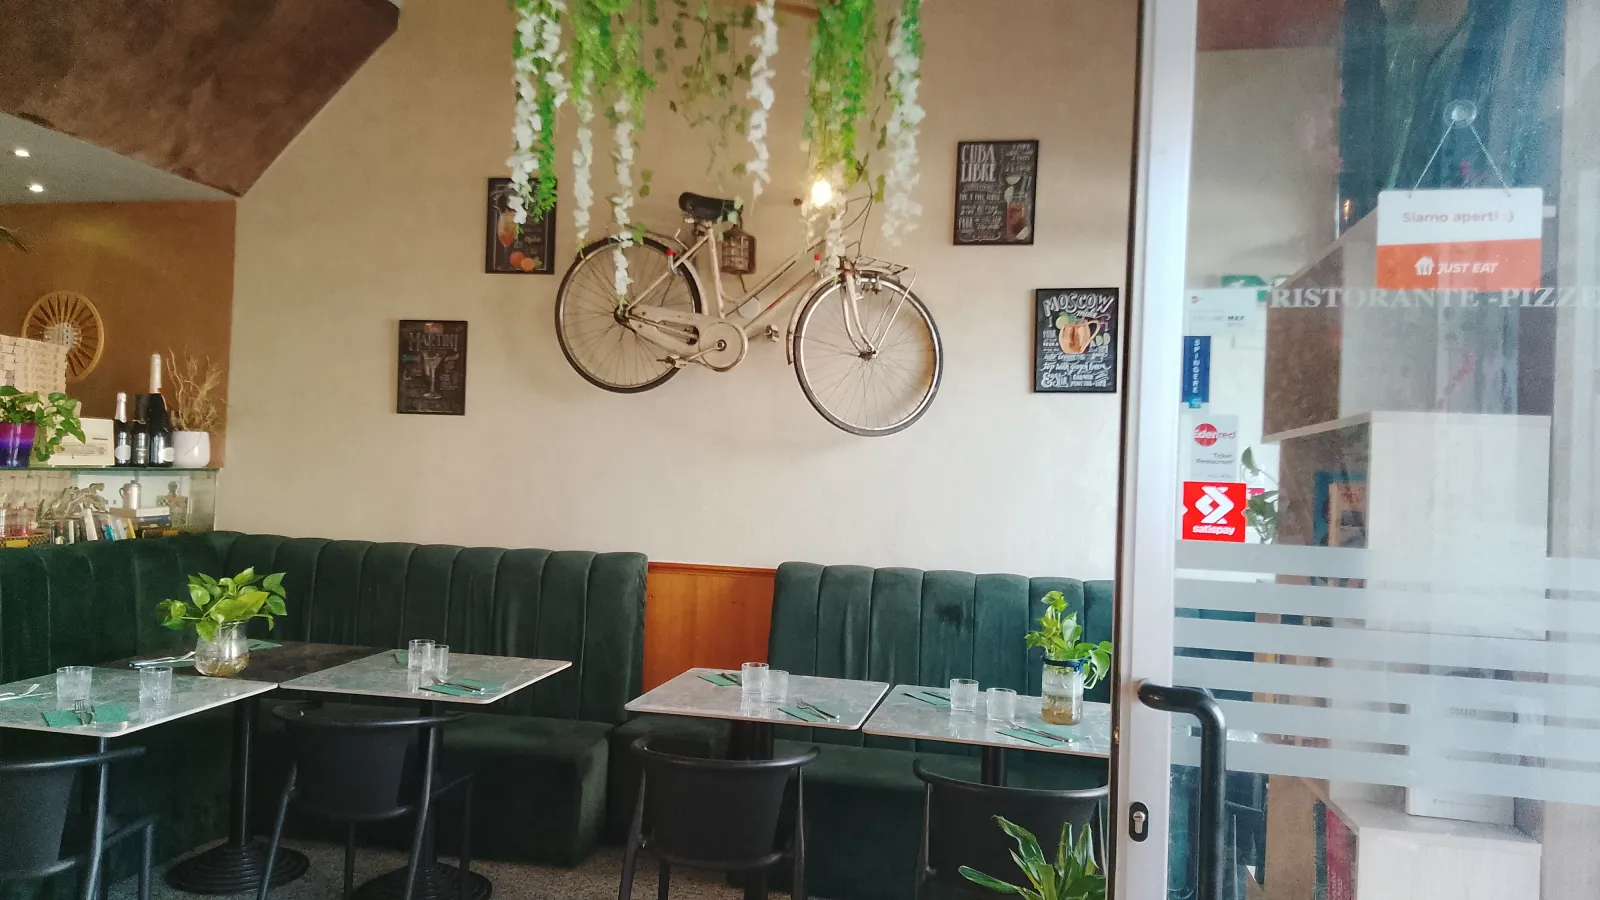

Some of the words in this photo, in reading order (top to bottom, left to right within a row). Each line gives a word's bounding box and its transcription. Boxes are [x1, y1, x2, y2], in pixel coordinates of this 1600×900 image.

[961, 144, 996, 164] CUBA
[961, 164, 997, 182] LIBRE
[1402, 211, 1449, 223] Siamo
[1453, 210, 1499, 224] aperti
[1437, 261, 1469, 275] JUST
[1472, 262, 1498, 274] EAT
[1043, 293, 1114, 318] MOSCOW
[1268, 287, 1480, 308] RISTORANTE
[1192, 338, 1201, 394] SPINGERE
[1193, 429, 1236, 440] Edenred
[1192, 525, 1236, 536] satispay
